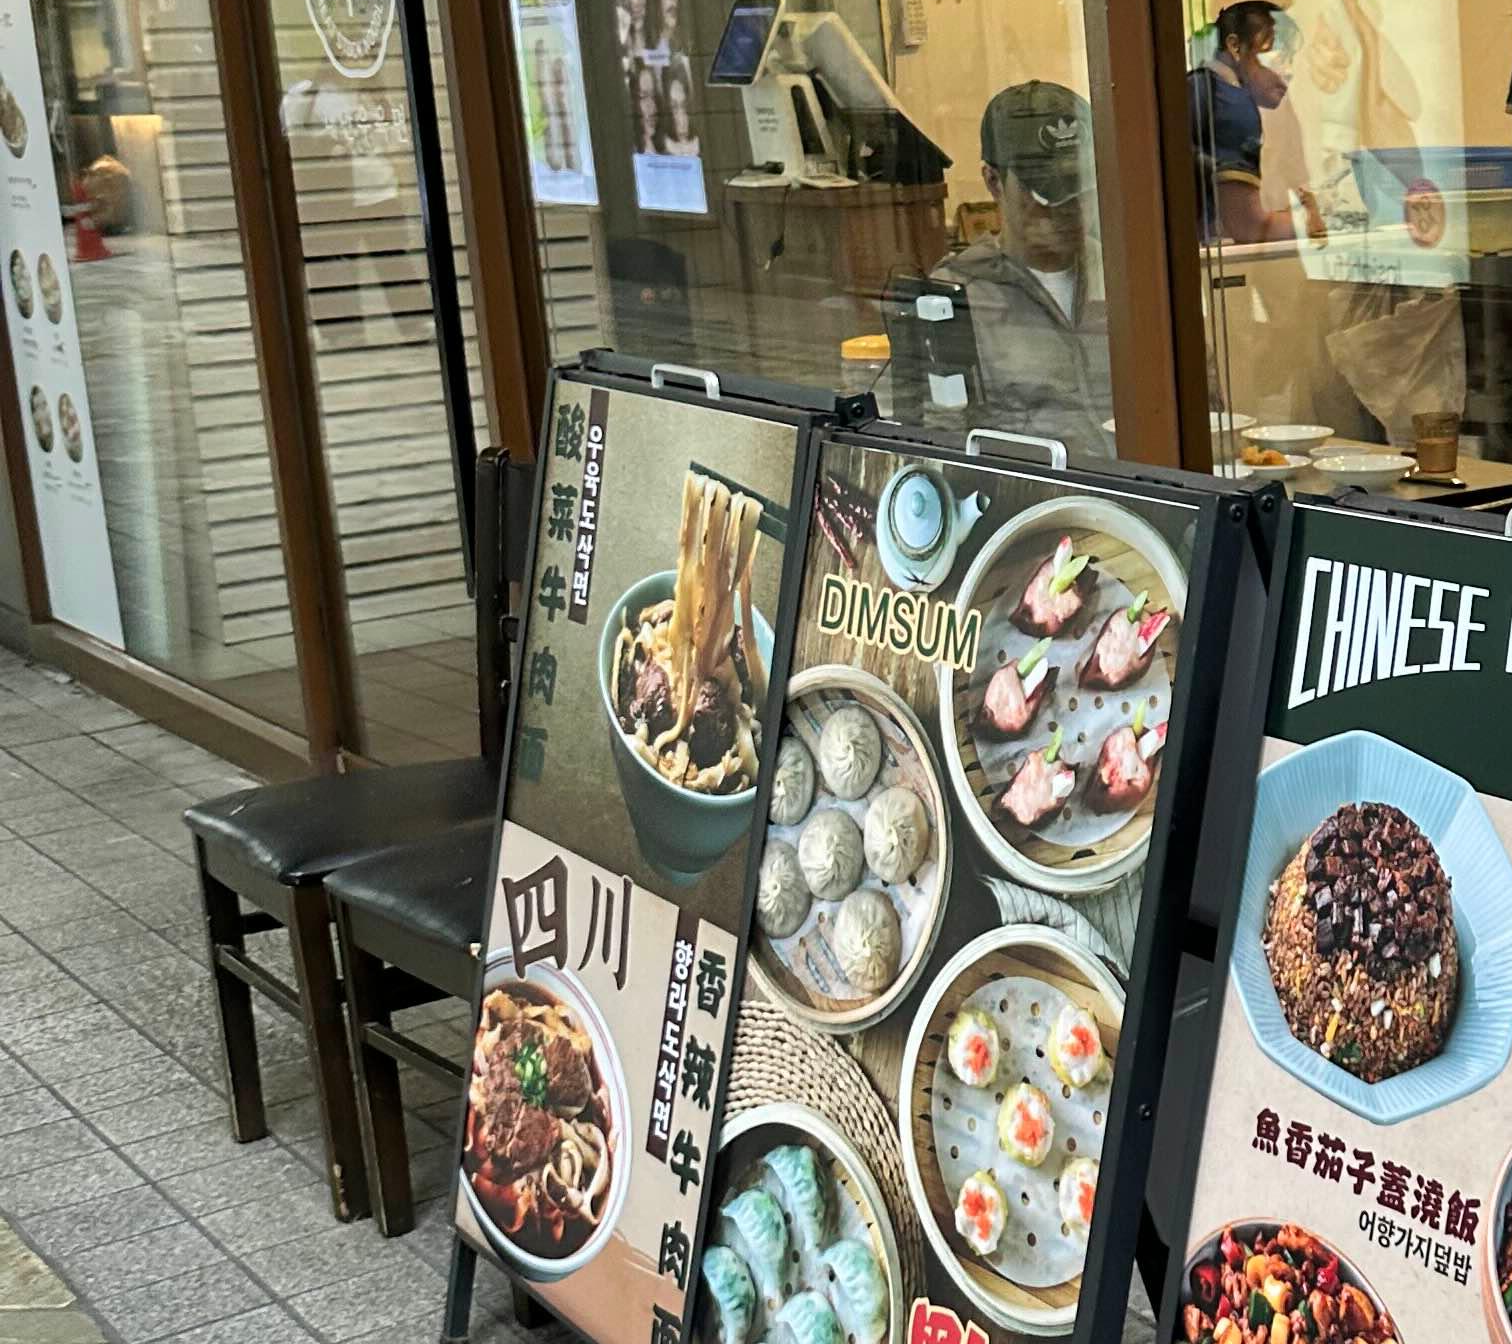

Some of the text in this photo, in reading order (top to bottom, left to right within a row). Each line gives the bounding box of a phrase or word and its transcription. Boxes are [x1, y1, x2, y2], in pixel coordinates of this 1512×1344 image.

[573, 424, 604, 606] 우육도삭면
[819, 576, 981, 670] DIMSUM
[1288, 557, 1490, 710] CHINESE
[502, 853, 634, 992] 四川
[1358, 1209, 1472, 1285] 어향가지덮밥
